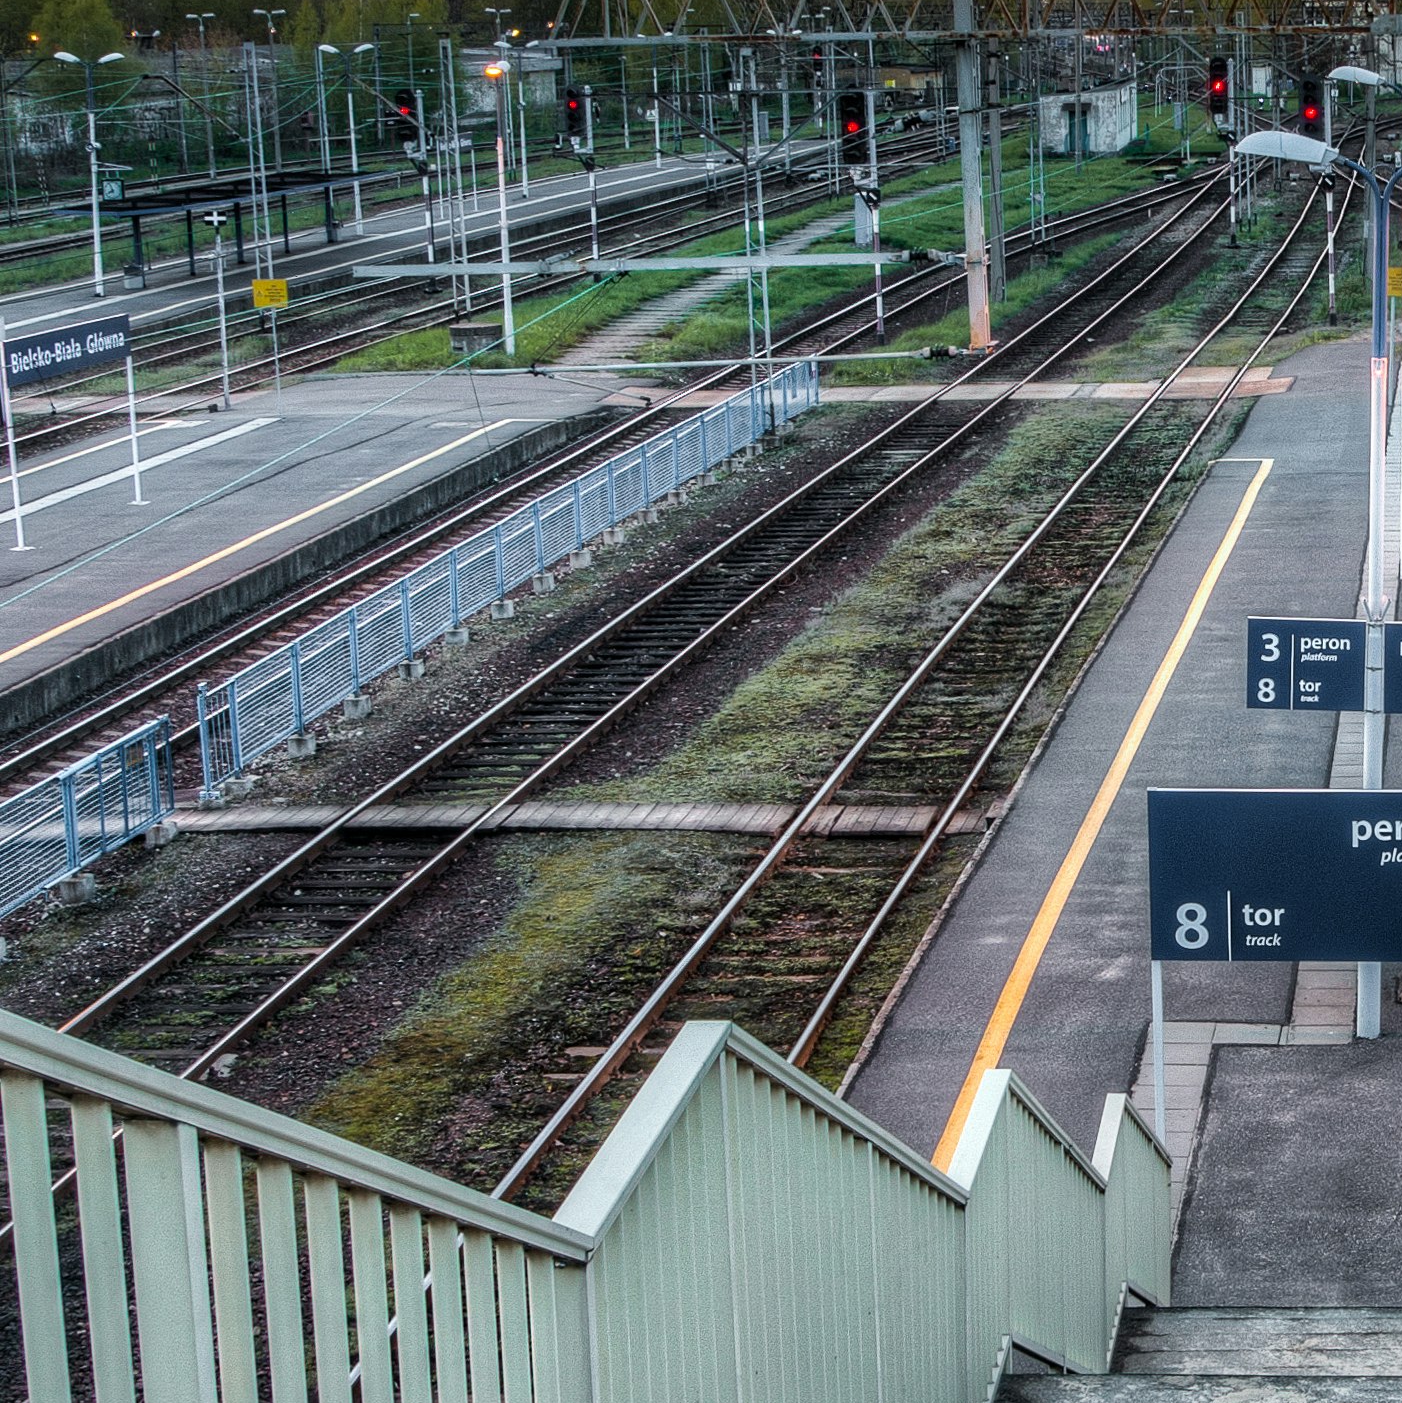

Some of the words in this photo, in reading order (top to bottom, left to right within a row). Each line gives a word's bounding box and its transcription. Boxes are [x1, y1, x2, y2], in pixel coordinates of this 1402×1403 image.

[10, 338, 82, 374] Bielsko-Biała
[86, 331, 125, 354] Główna
[1260, 633, 1281, 663] 3
[1300, 637, 1351, 654] peron
[1301, 653, 1338, 663] platform
[1257, 677, 1277, 703] 8
[1299, 679, 1321, 693] tor
[1301, 694, 1320, 703] track
[1175, 902, 1209, 950] 8
[1242, 904, 1285, 926] tor
[1245, 933, 1282, 947] track
